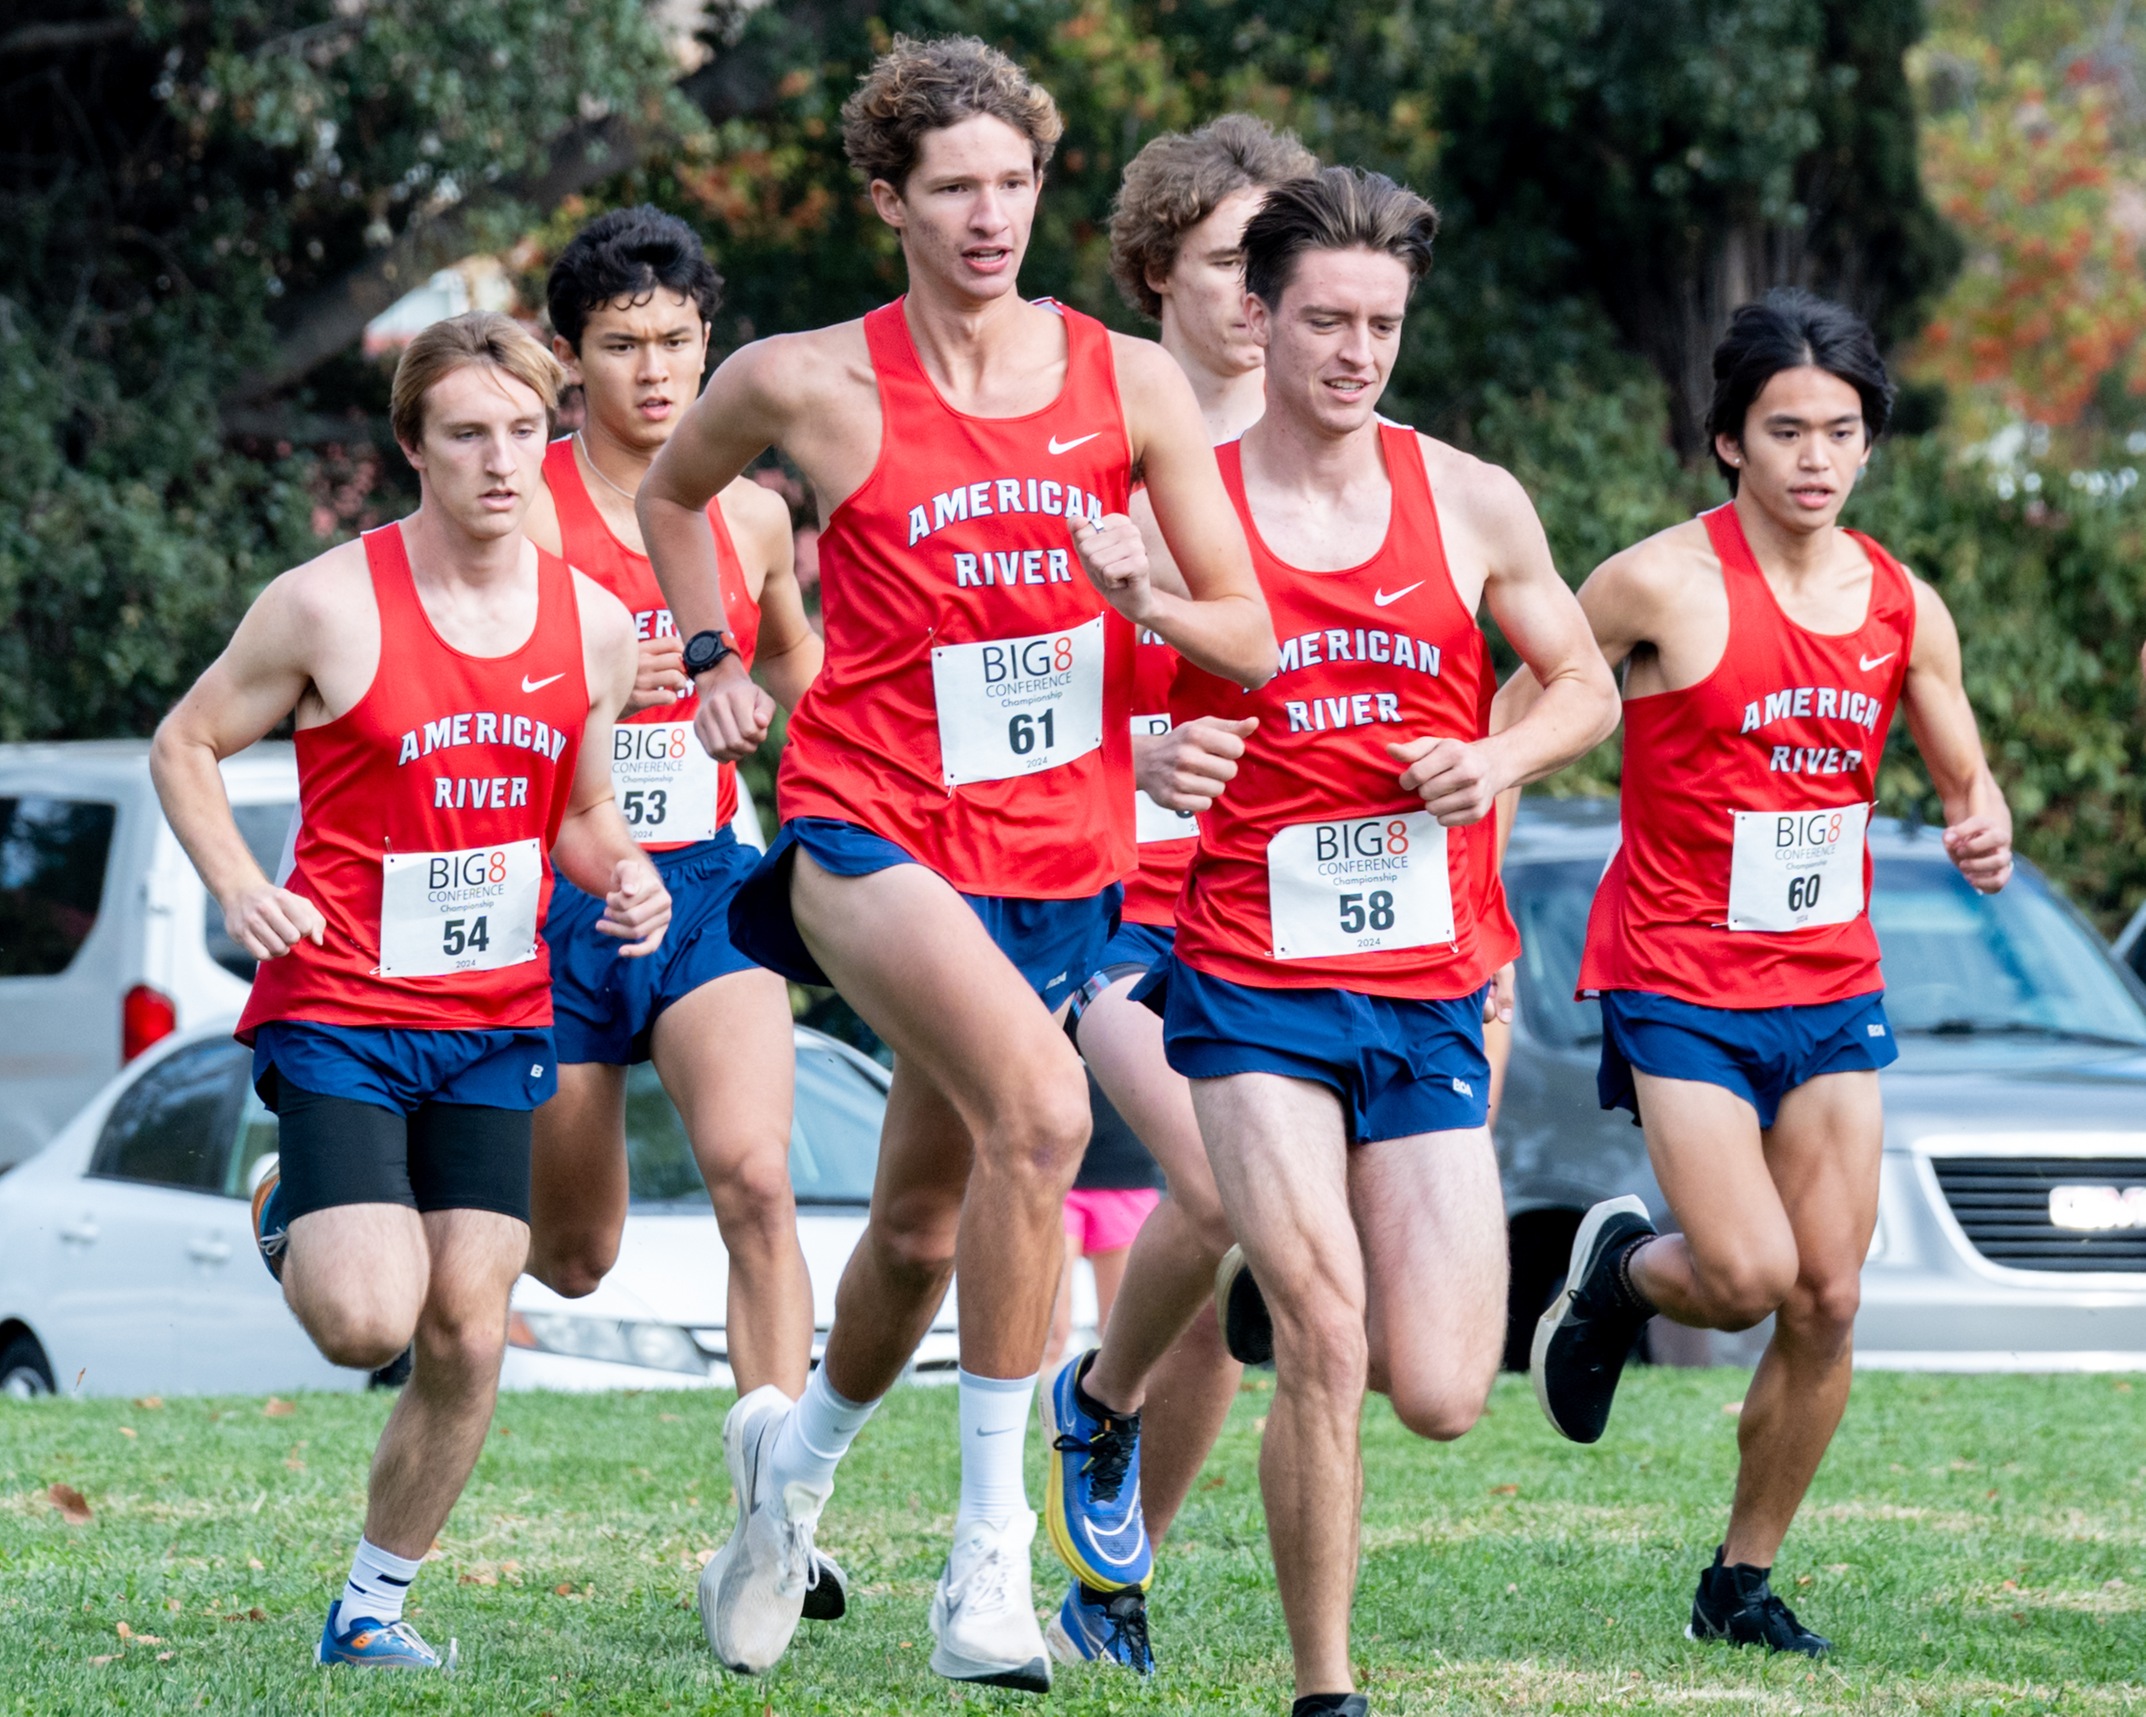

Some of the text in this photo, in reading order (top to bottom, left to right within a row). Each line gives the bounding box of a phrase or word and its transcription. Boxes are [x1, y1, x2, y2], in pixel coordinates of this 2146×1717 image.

[908, 478, 1104, 547] AMERICAN
[953, 548, 1072, 587] RIVER
[982, 637, 1073, 683] BIG8
[1243, 628, 1440, 693] MERICAN
[986, 671, 1072, 698] CONFERENCE
[1001, 690, 1063, 708] Championship
[1285, 692, 1403, 733] RIVER
[1740, 687, 1882, 735] AMERICA
[398, 712, 567, 767] AMERICAN
[614, 728, 686, 761] BIG8
[1008, 708, 1054, 755] 61
[612, 760, 683, 774] CONFERENCE
[1026, 756, 1048, 768] 2024
[1770, 745, 1863, 775] RIVER
[434, 777, 528, 809] RIVER
[622, 774, 674, 784] Championship
[623, 790, 667, 825] 53
[633, 830, 653, 839] 2024
[1316, 820, 1409, 861] BIG8
[1776, 813, 1842, 847] BIG8
[1318, 855, 1408, 876] CONFERENCE
[1775, 844, 1836, 861] CONFERENCE
[429, 851, 506, 889] BIG8
[1333, 873, 1398, 886] Championship
[428, 884, 504, 903] CONFERENCE
[440, 899, 495, 913] Championship
[1788, 874, 1821, 912] 60
[1339, 890, 1395, 934] 58
[443, 916, 489, 956] 54
[1357, 937, 1381, 948] 2024
[456, 959, 476, 969] 2024
